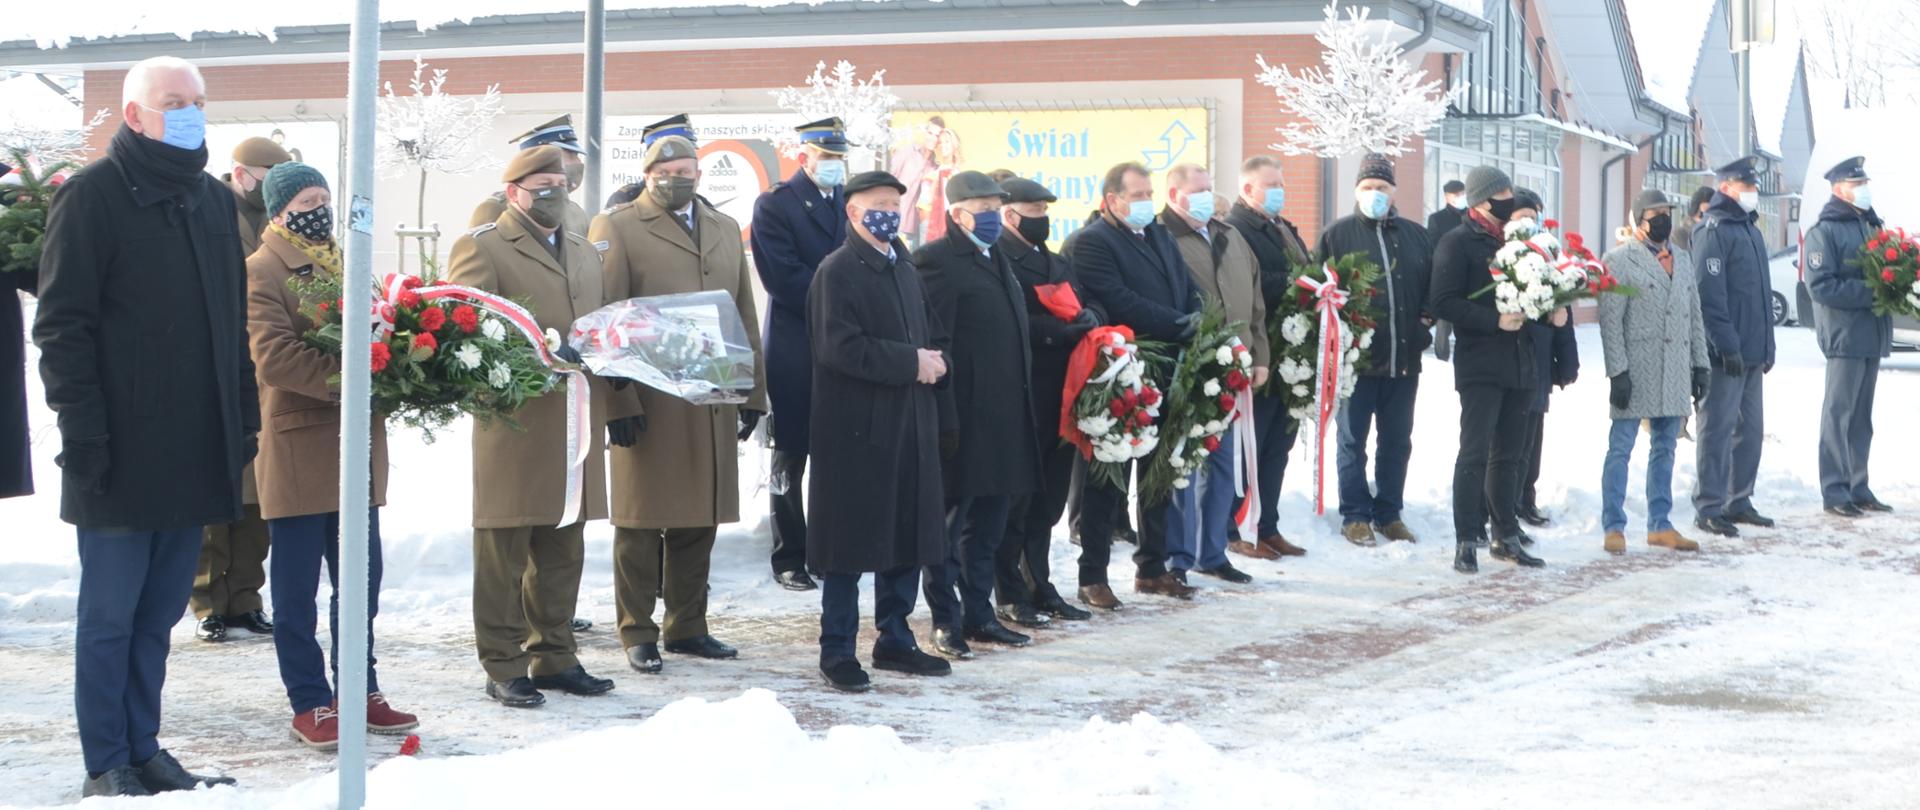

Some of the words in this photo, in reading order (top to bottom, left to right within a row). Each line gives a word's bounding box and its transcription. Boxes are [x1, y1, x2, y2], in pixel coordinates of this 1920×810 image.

[618, 126, 642, 138] Zapr
[703, 124, 748, 137] naszych
[1007, 119, 1089, 158] Świat
[612, 147, 647, 160] Dział
[612, 172, 644, 185] Mław
[708, 167, 738, 177] adidas
[708, 183, 737, 192] Reebok
